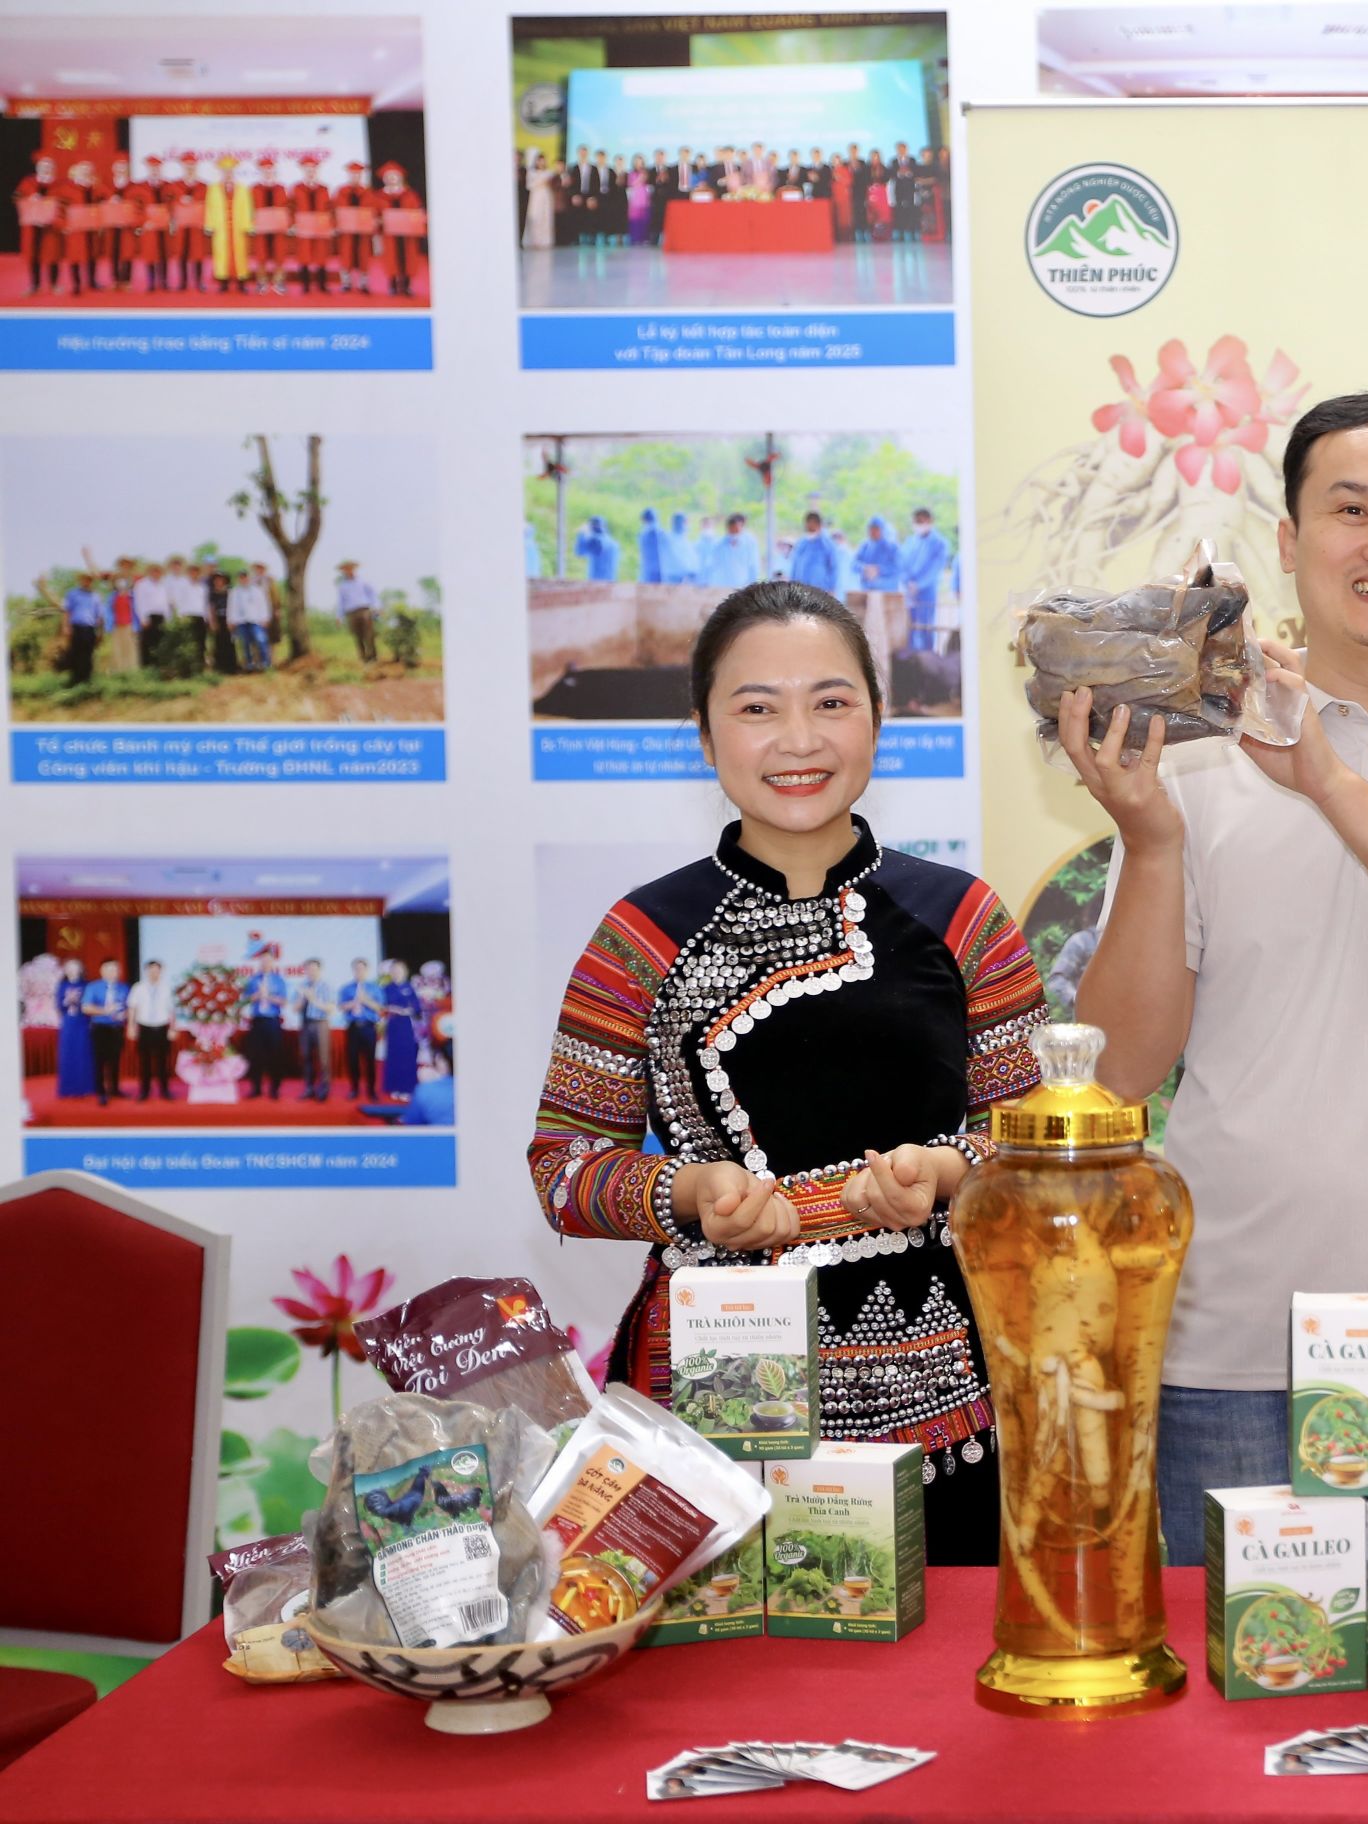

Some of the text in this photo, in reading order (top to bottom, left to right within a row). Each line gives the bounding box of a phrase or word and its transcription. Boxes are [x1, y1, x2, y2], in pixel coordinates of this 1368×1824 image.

[1048, 263, 1158, 282] THIÊN PHÚC
[749, 1317, 791, 1327] NHUNG
[1308, 1339, 1334, 1360] CÀ
[1242, 1538, 1352, 1562] CÀ GAI LEO
